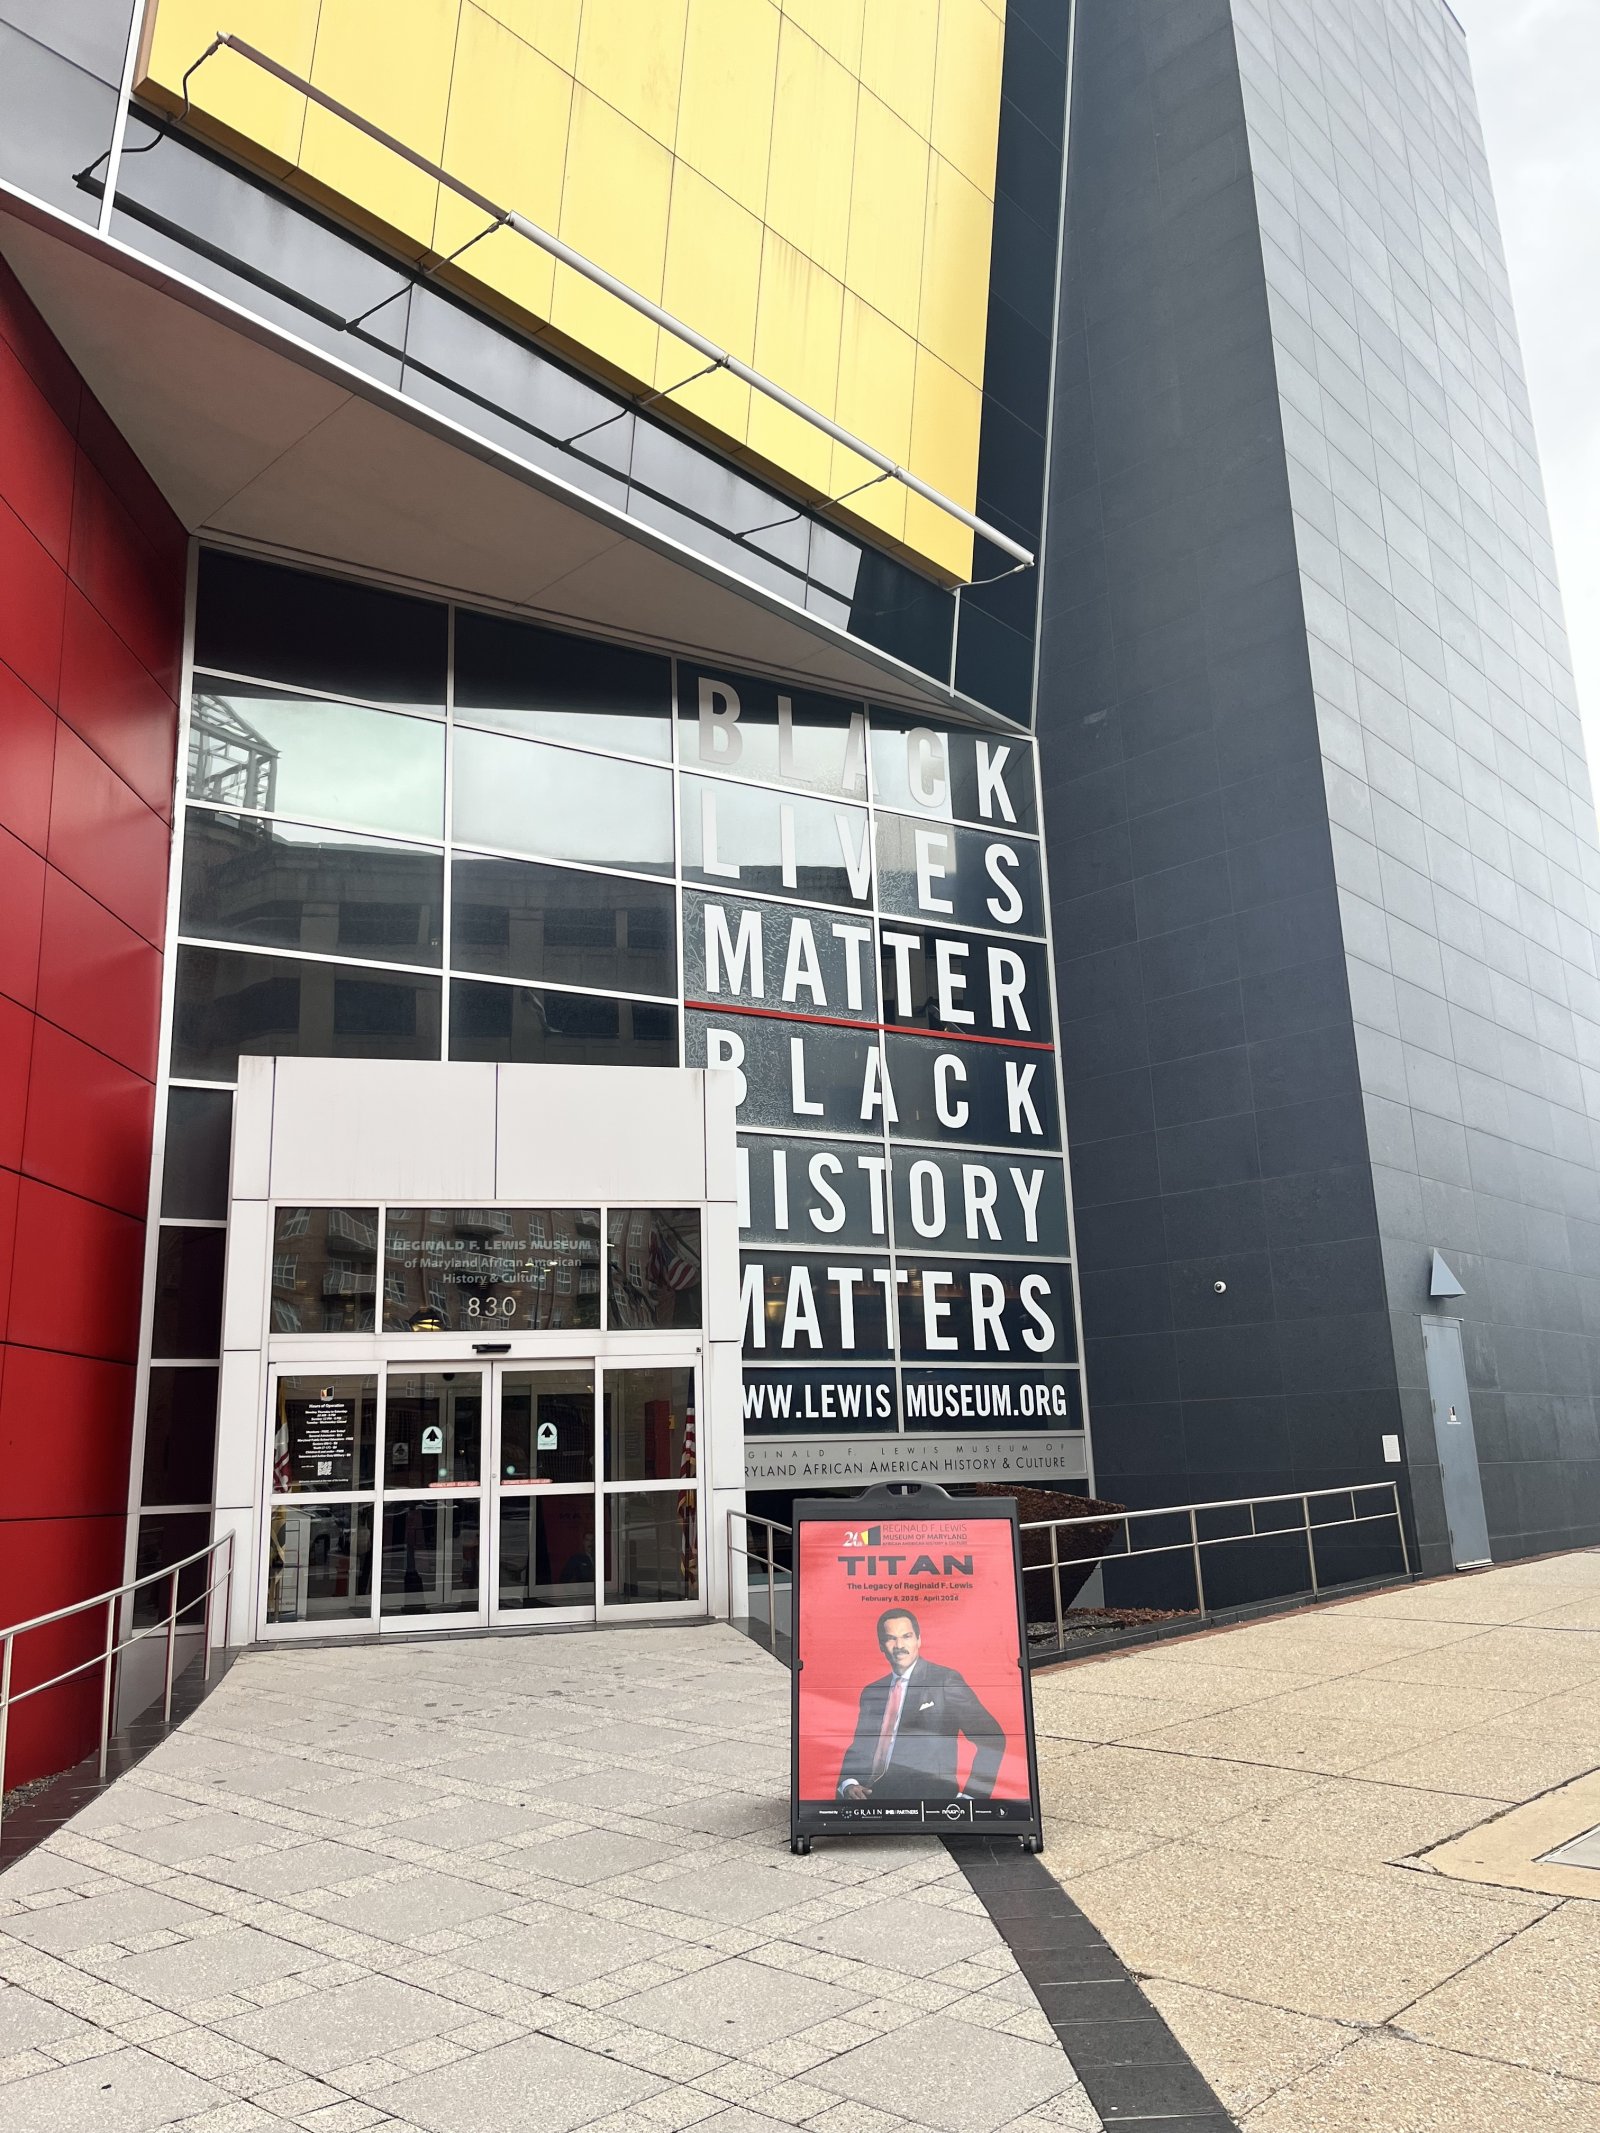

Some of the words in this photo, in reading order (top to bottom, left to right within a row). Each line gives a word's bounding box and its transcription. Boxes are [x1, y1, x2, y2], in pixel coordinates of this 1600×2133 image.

[698, 676, 1018, 824] BLACK
[701, 787, 1024, 925] LIVES
[704, 904, 1032, 1032] MATTER
[706, 1028, 1044, 1136] BLACK
[393, 1240, 465, 1250] REGINALD
[469, 1240, 480, 1250] F.
[485, 1240, 527, 1250] LEWIS
[531, 1240, 591, 1250] MUSEUM
[404, 1258, 418, 1268] of
[420, 1257, 478, 1270] Maryland
[480, 1257, 524, 1267] African
[527, 1257, 582, 1268] American
[443, 1273, 487, 1286] History
[489, 1273, 499, 1284] &
[501, 1272, 545, 1283] Culture
[468, 1296, 517, 1317] 830
[748, 1450, 825, 1459] GINALD
[881, 1446, 938, 1455] LEWIS
[956, 1444, 1029, 1453] MUSEUM
[744, 1464, 797, 1477] RYLAND
[803, 1462, 863, 1475] AFRICAN
[869, 1461, 939, 1474] AMERICAN
[944, 1458, 997, 1471] HISTORY
[1002, 1457, 1011, 1469] &
[1016, 1456, 1065, 1469] CULTURE
[882, 1524, 927, 1533] REGINALD
[837, 1555, 974, 1576] TITAN
[863, 1582, 892, 1591] Legacy
[894, 1582, 902, 1590] of
[904, 1582, 940, 1591] Reginald
